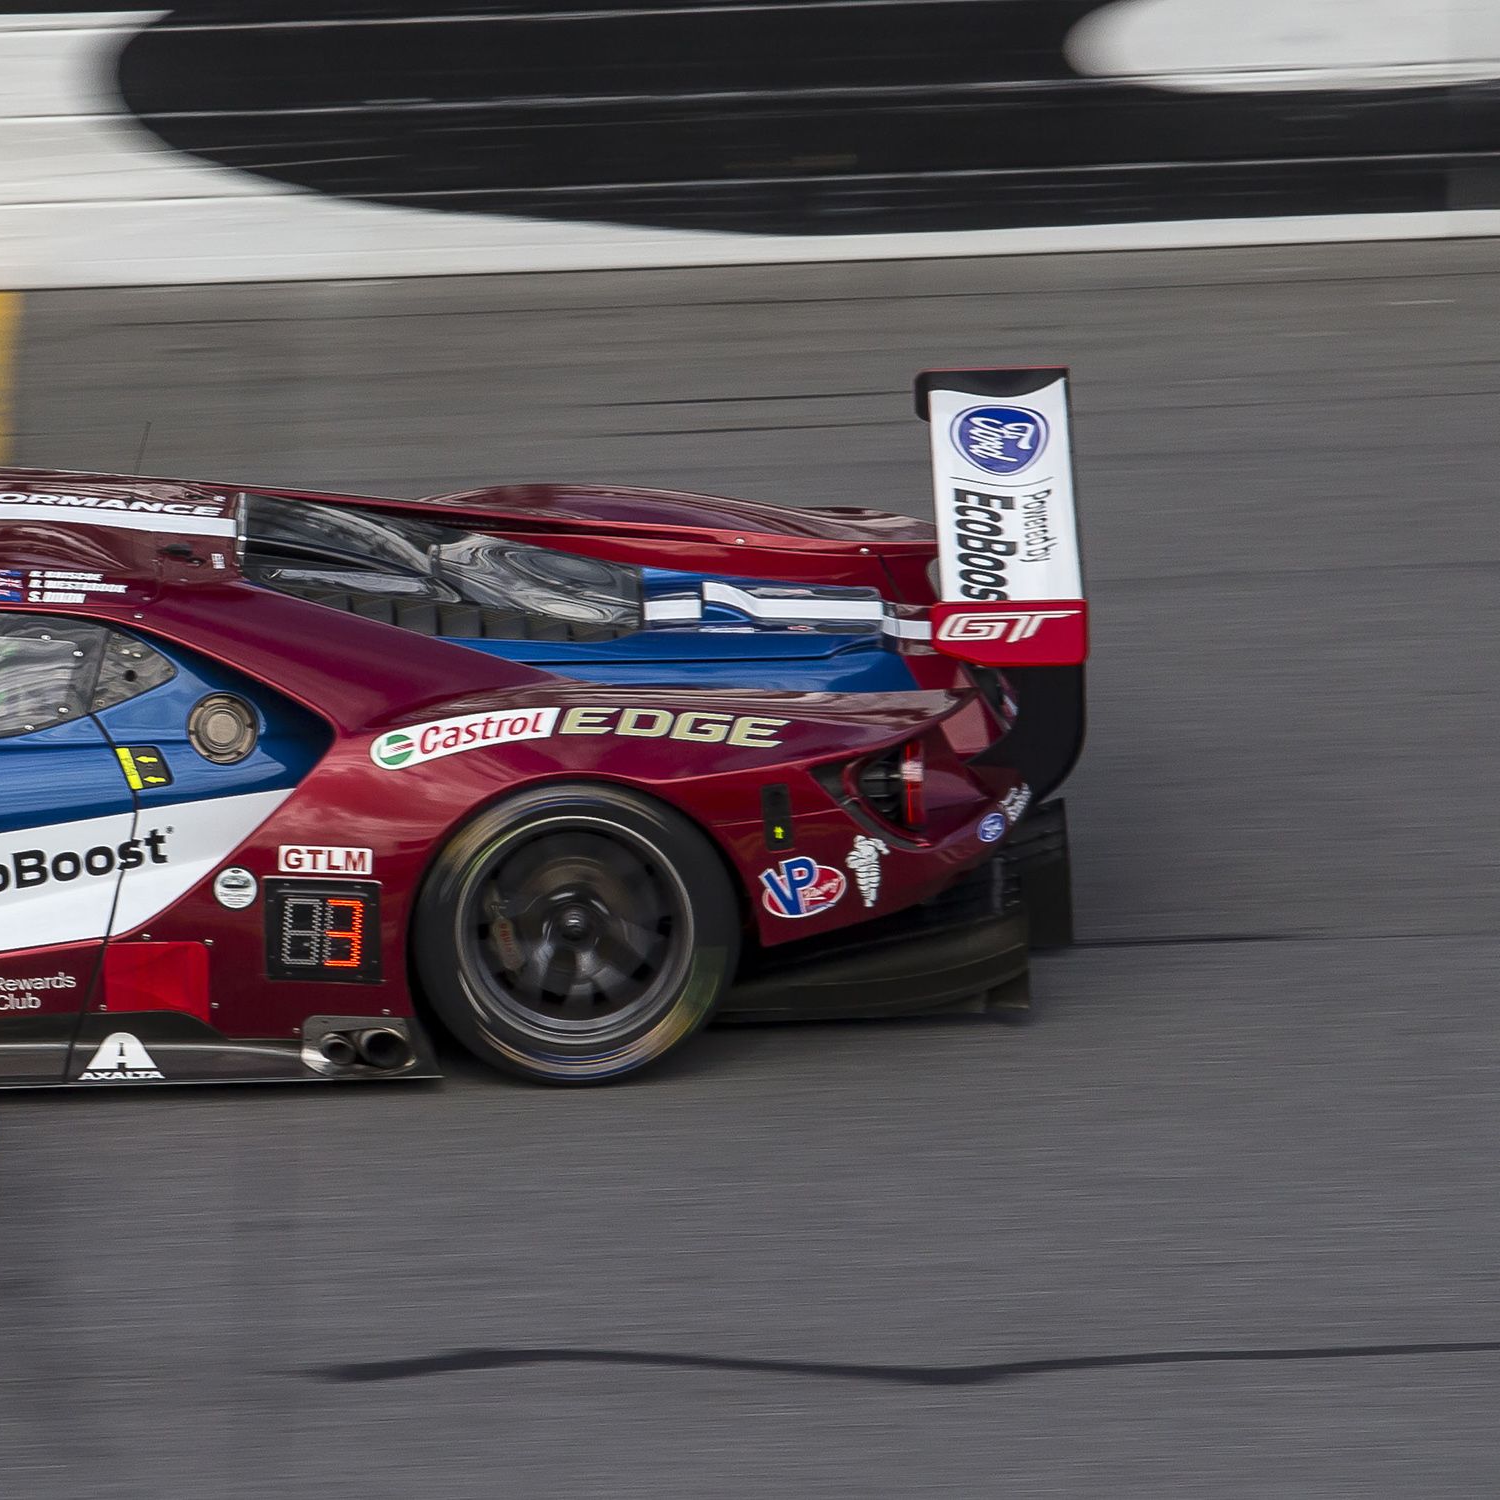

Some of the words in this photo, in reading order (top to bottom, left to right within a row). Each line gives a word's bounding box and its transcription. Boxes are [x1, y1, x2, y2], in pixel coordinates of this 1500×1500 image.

[968, 416, 1036, 462] Ford
[1022, 488, 1057, 545] Powered
[1020, 543, 1058, 562] by
[936, 609, 1082, 643] GT
[419, 711, 545, 755] Castrol
[558, 706, 792, 748] EDGE
[284, 848, 366, 872] GTLM
[761, 856, 817, 916] VP
[78, 1071, 166, 1081] AXALTA
